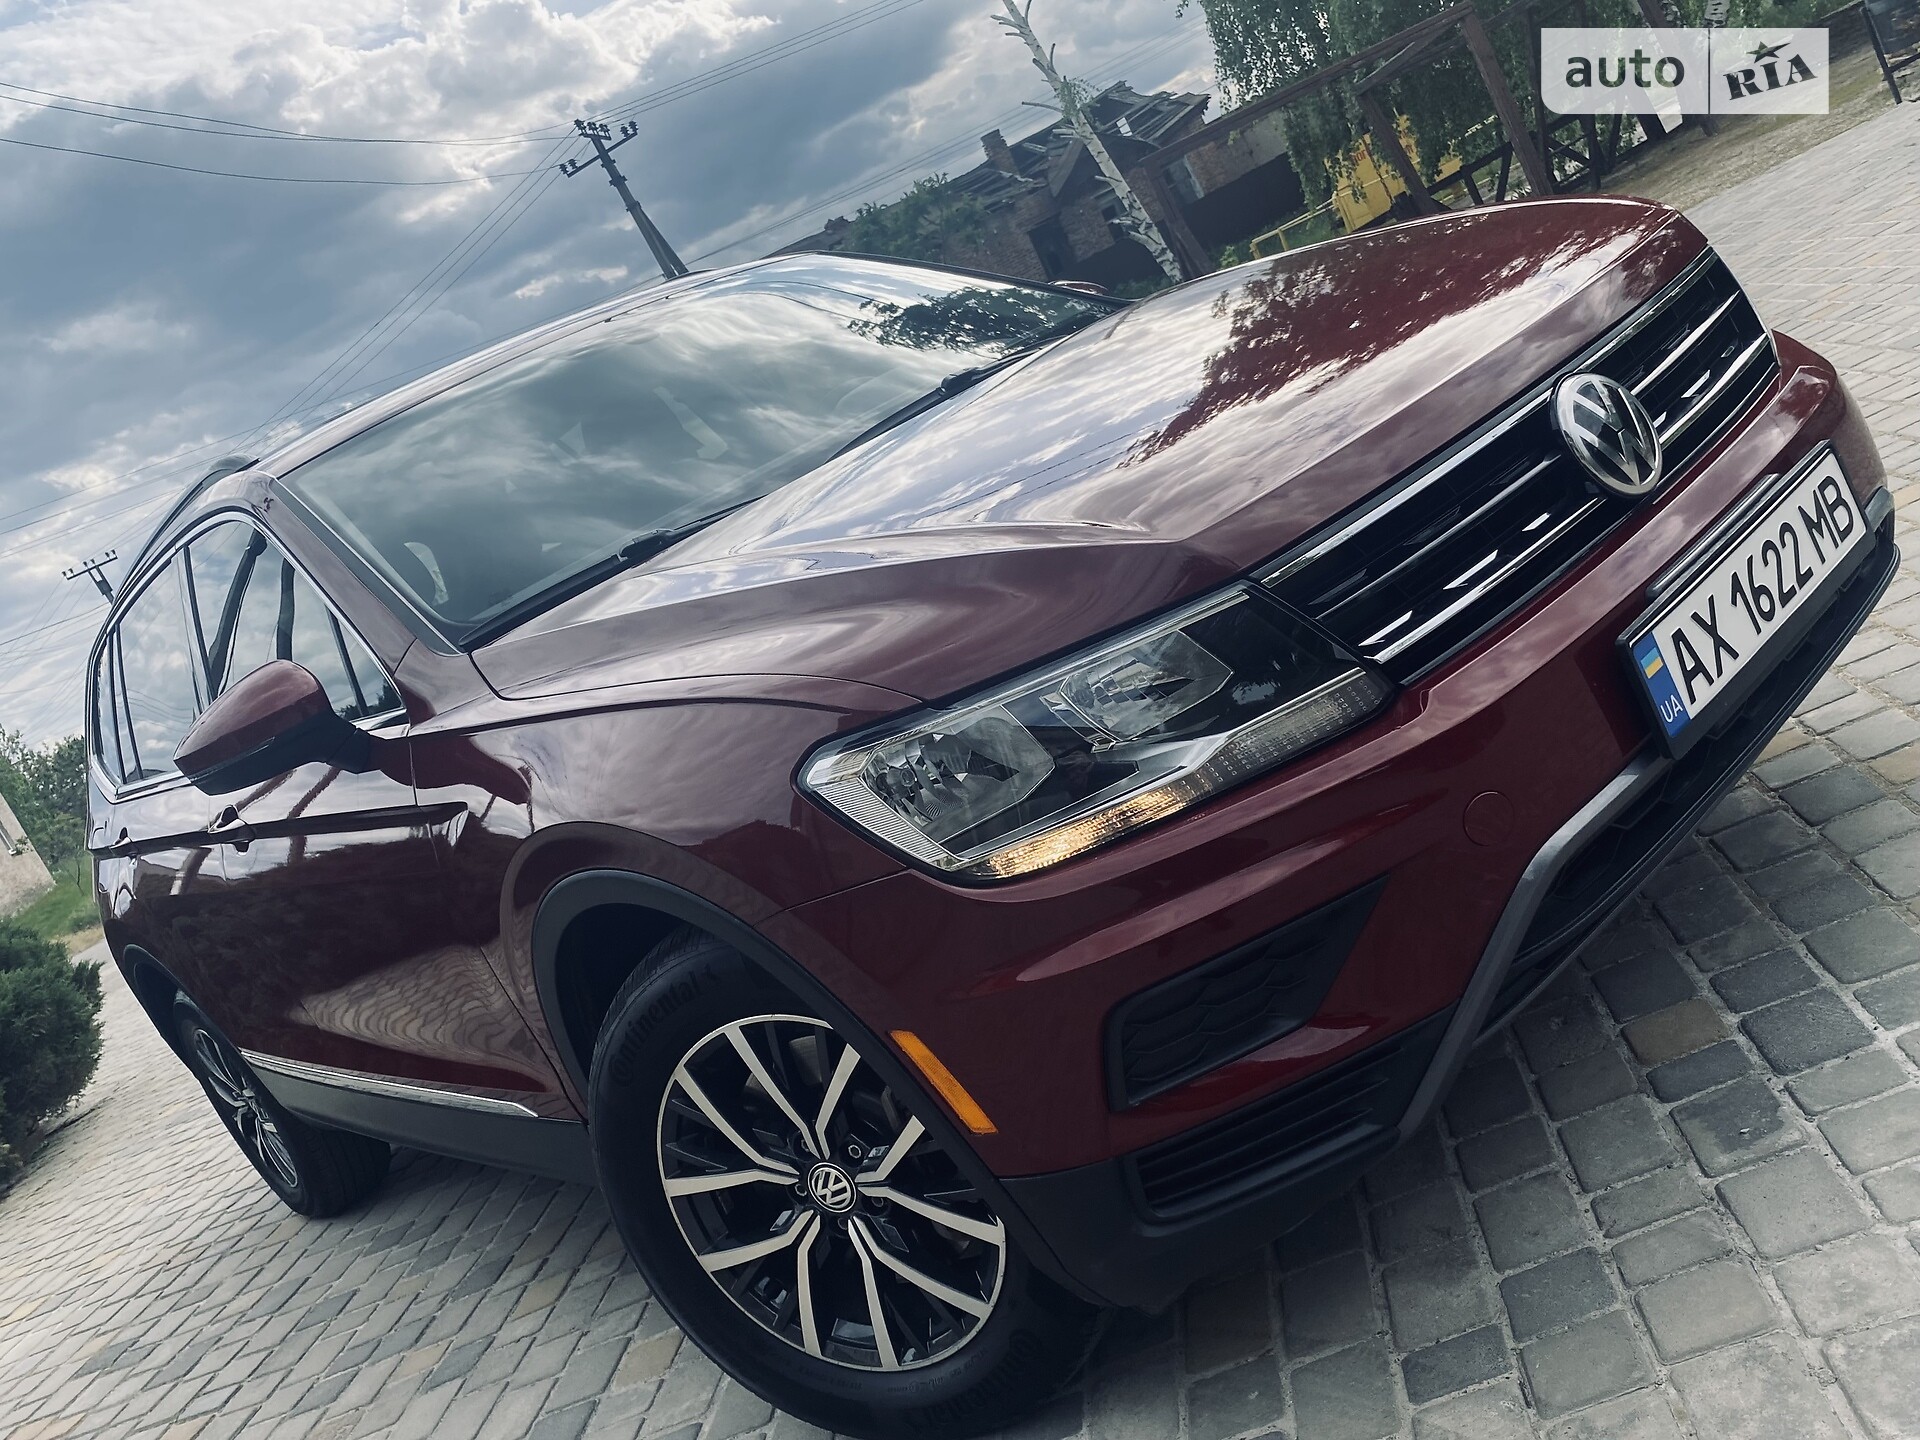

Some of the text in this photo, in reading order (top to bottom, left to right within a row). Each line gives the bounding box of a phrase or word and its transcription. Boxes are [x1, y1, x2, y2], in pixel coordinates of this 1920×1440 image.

[1670, 475, 1854, 706] AX 1622 MB
[1660, 694, 1684, 723] UA
[608, 970, 702, 1086] Continental
